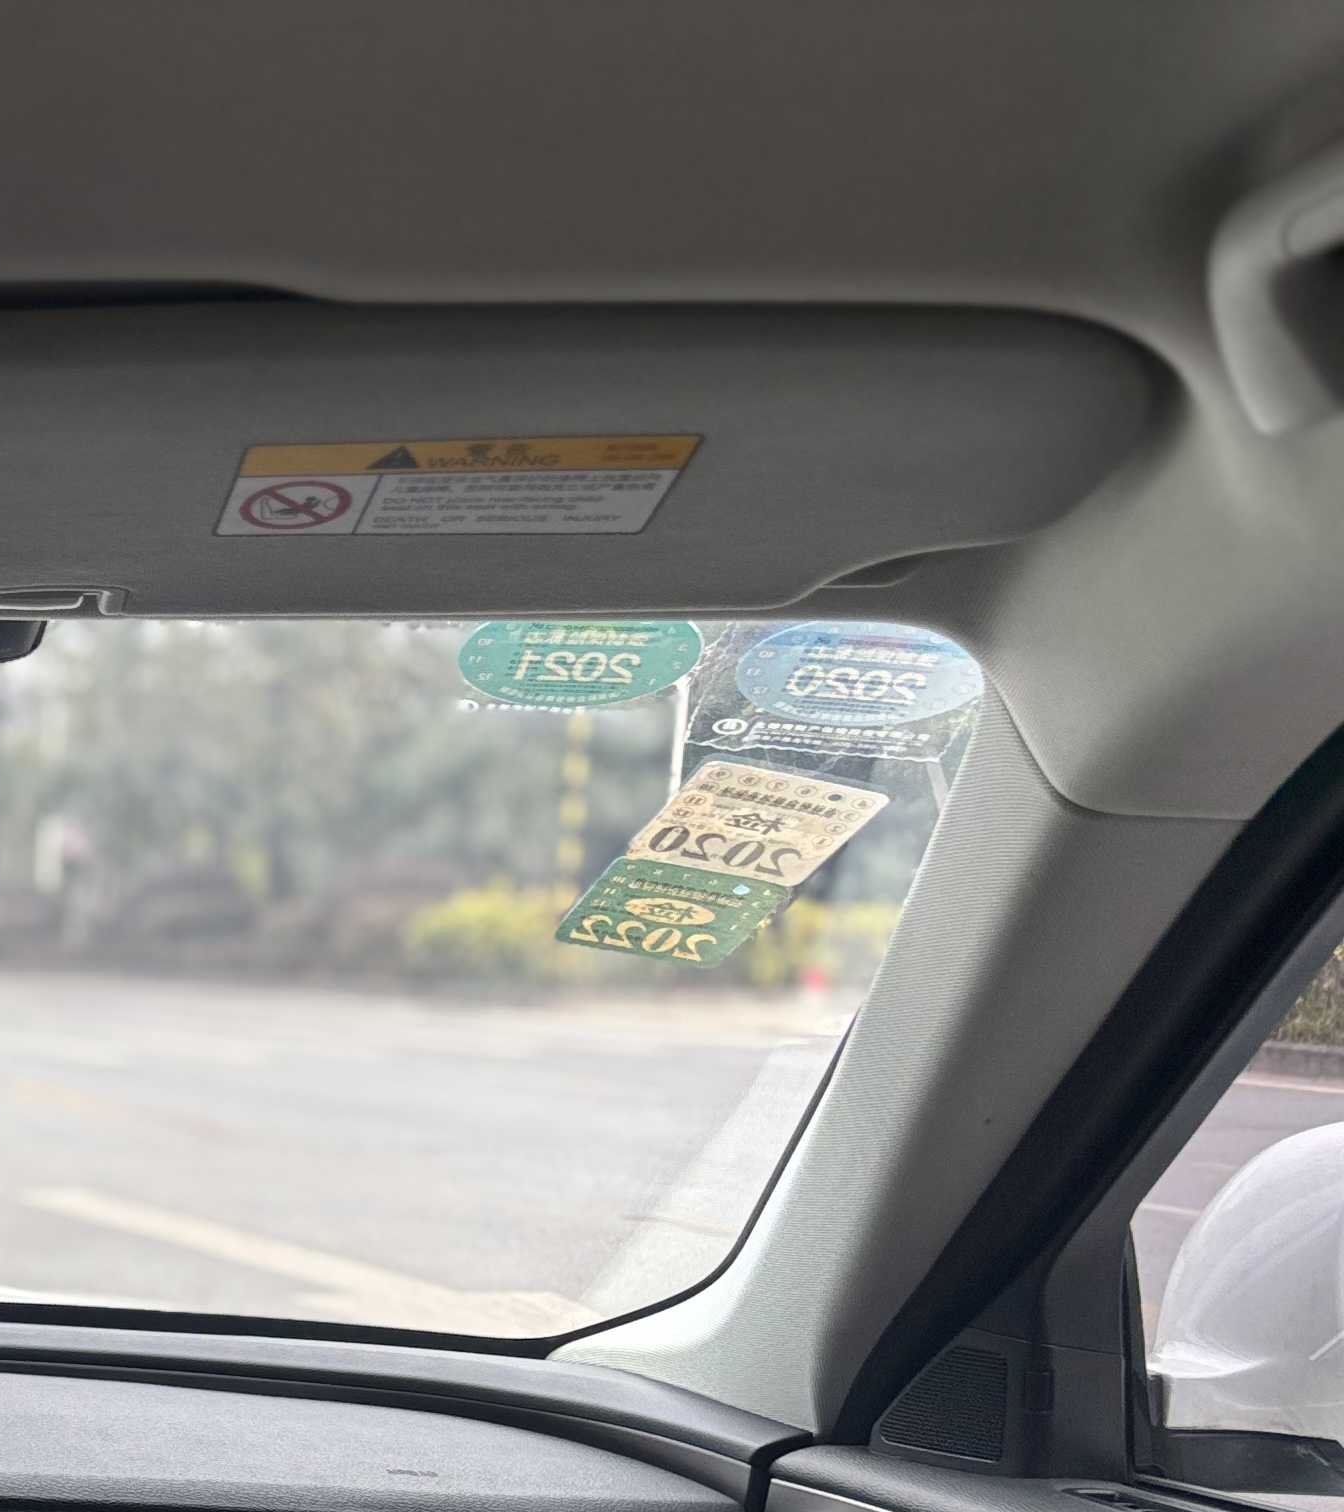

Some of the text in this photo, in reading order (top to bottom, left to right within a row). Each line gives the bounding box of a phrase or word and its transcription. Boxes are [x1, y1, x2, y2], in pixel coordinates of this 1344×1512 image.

[427, 454, 561, 468] WARNING
[410, 496, 445, 505] NOT
[372, 515, 429, 524] DEATH
[440, 515, 466, 523] OR
